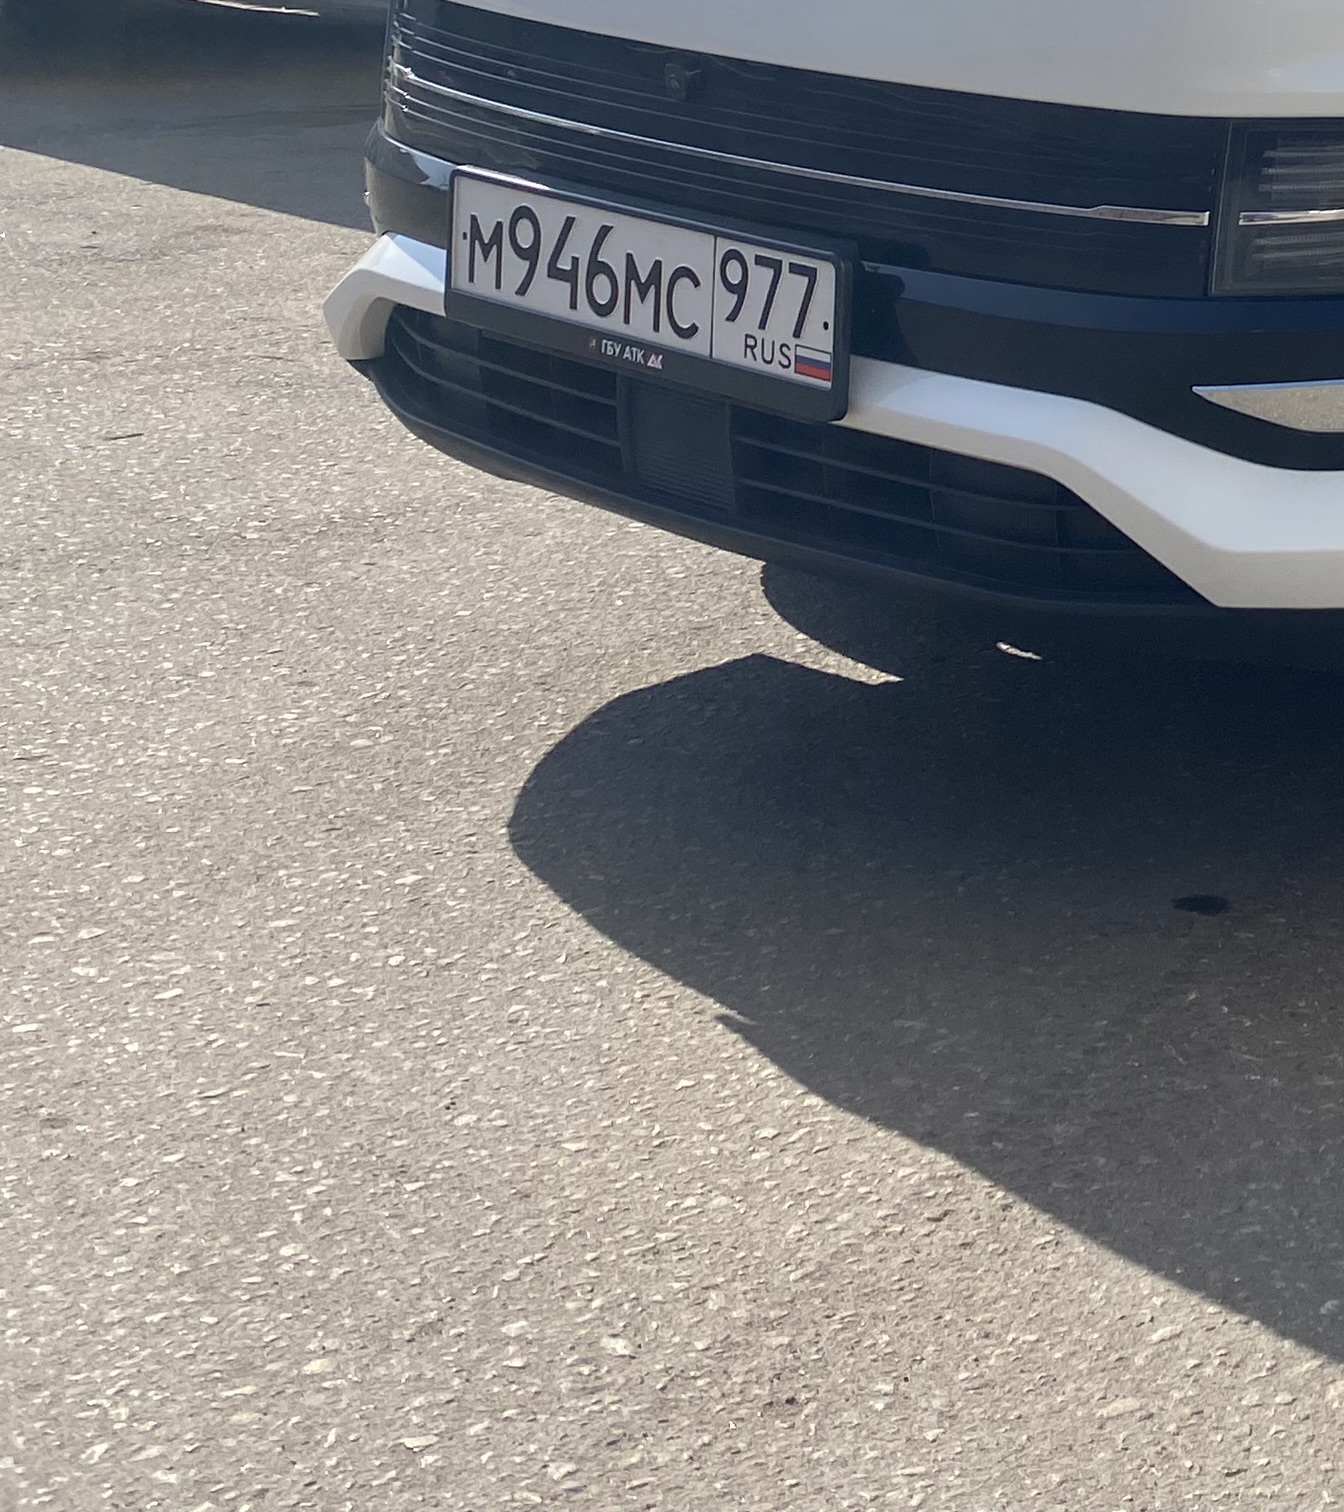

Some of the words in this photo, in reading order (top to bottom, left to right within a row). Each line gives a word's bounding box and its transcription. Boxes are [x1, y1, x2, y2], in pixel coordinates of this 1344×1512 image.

[468, 204, 701, 340] М946МС
[719, 248, 817, 339] 977
[601, 338, 622, 357] ГБУ
[622, 345, 645, 365] АТК
[743, 333, 792, 369] RUS
